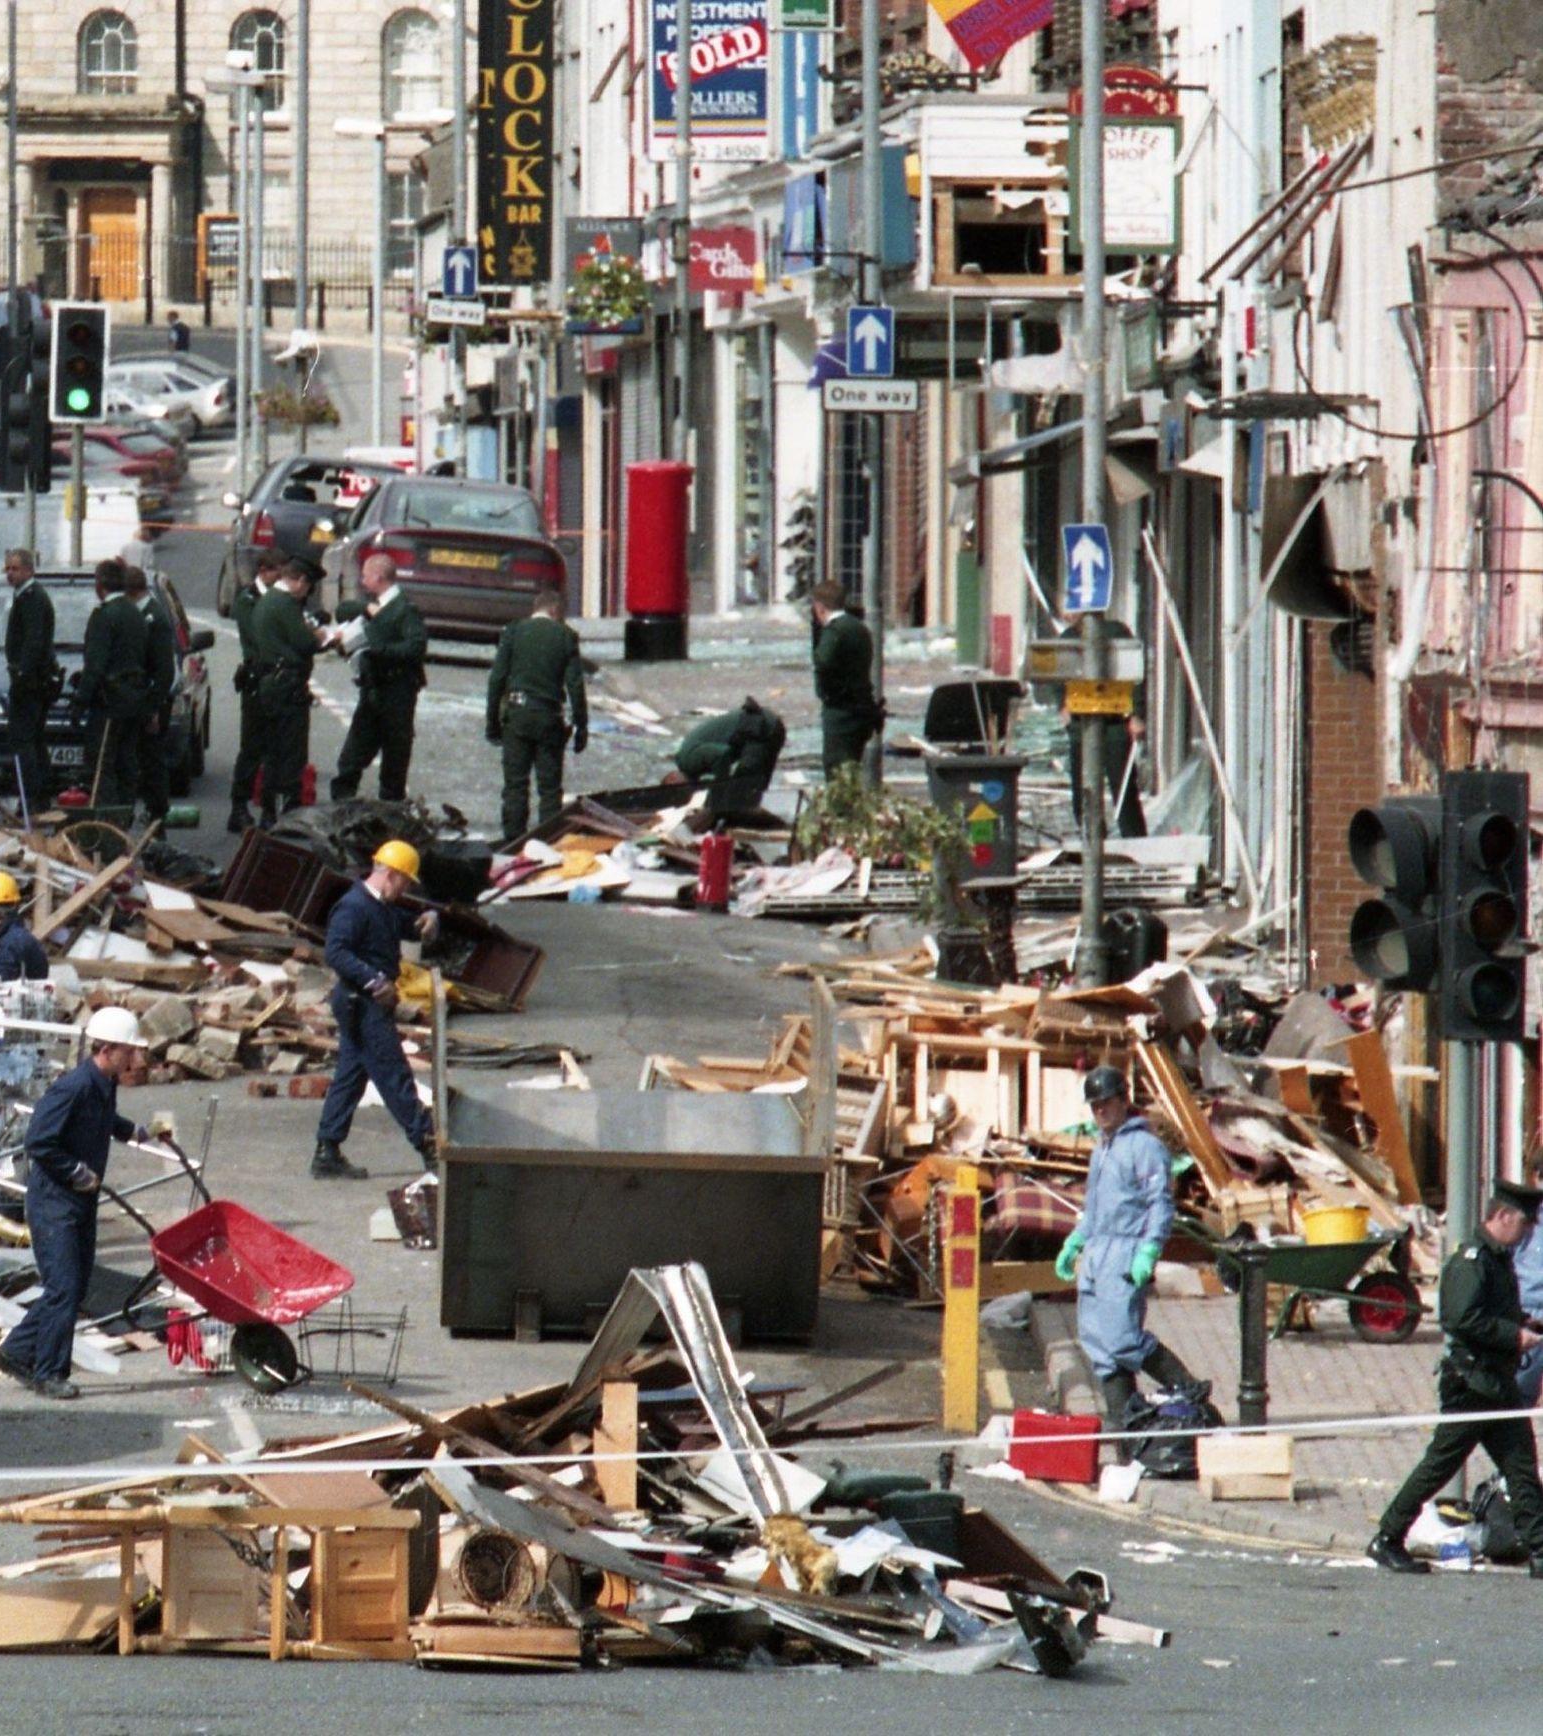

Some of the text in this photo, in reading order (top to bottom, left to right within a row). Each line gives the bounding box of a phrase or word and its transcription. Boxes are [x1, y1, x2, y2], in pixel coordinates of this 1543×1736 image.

[656, 2, 767, 20] INESTMENT
[502, 0, 546, 197] LOCK
[1104, 126, 1160, 150] OFFEE
[1108, 149, 1147, 161] SHOP
[506, 203, 542, 224] BAR
[831, 385, 912, 406] One way
